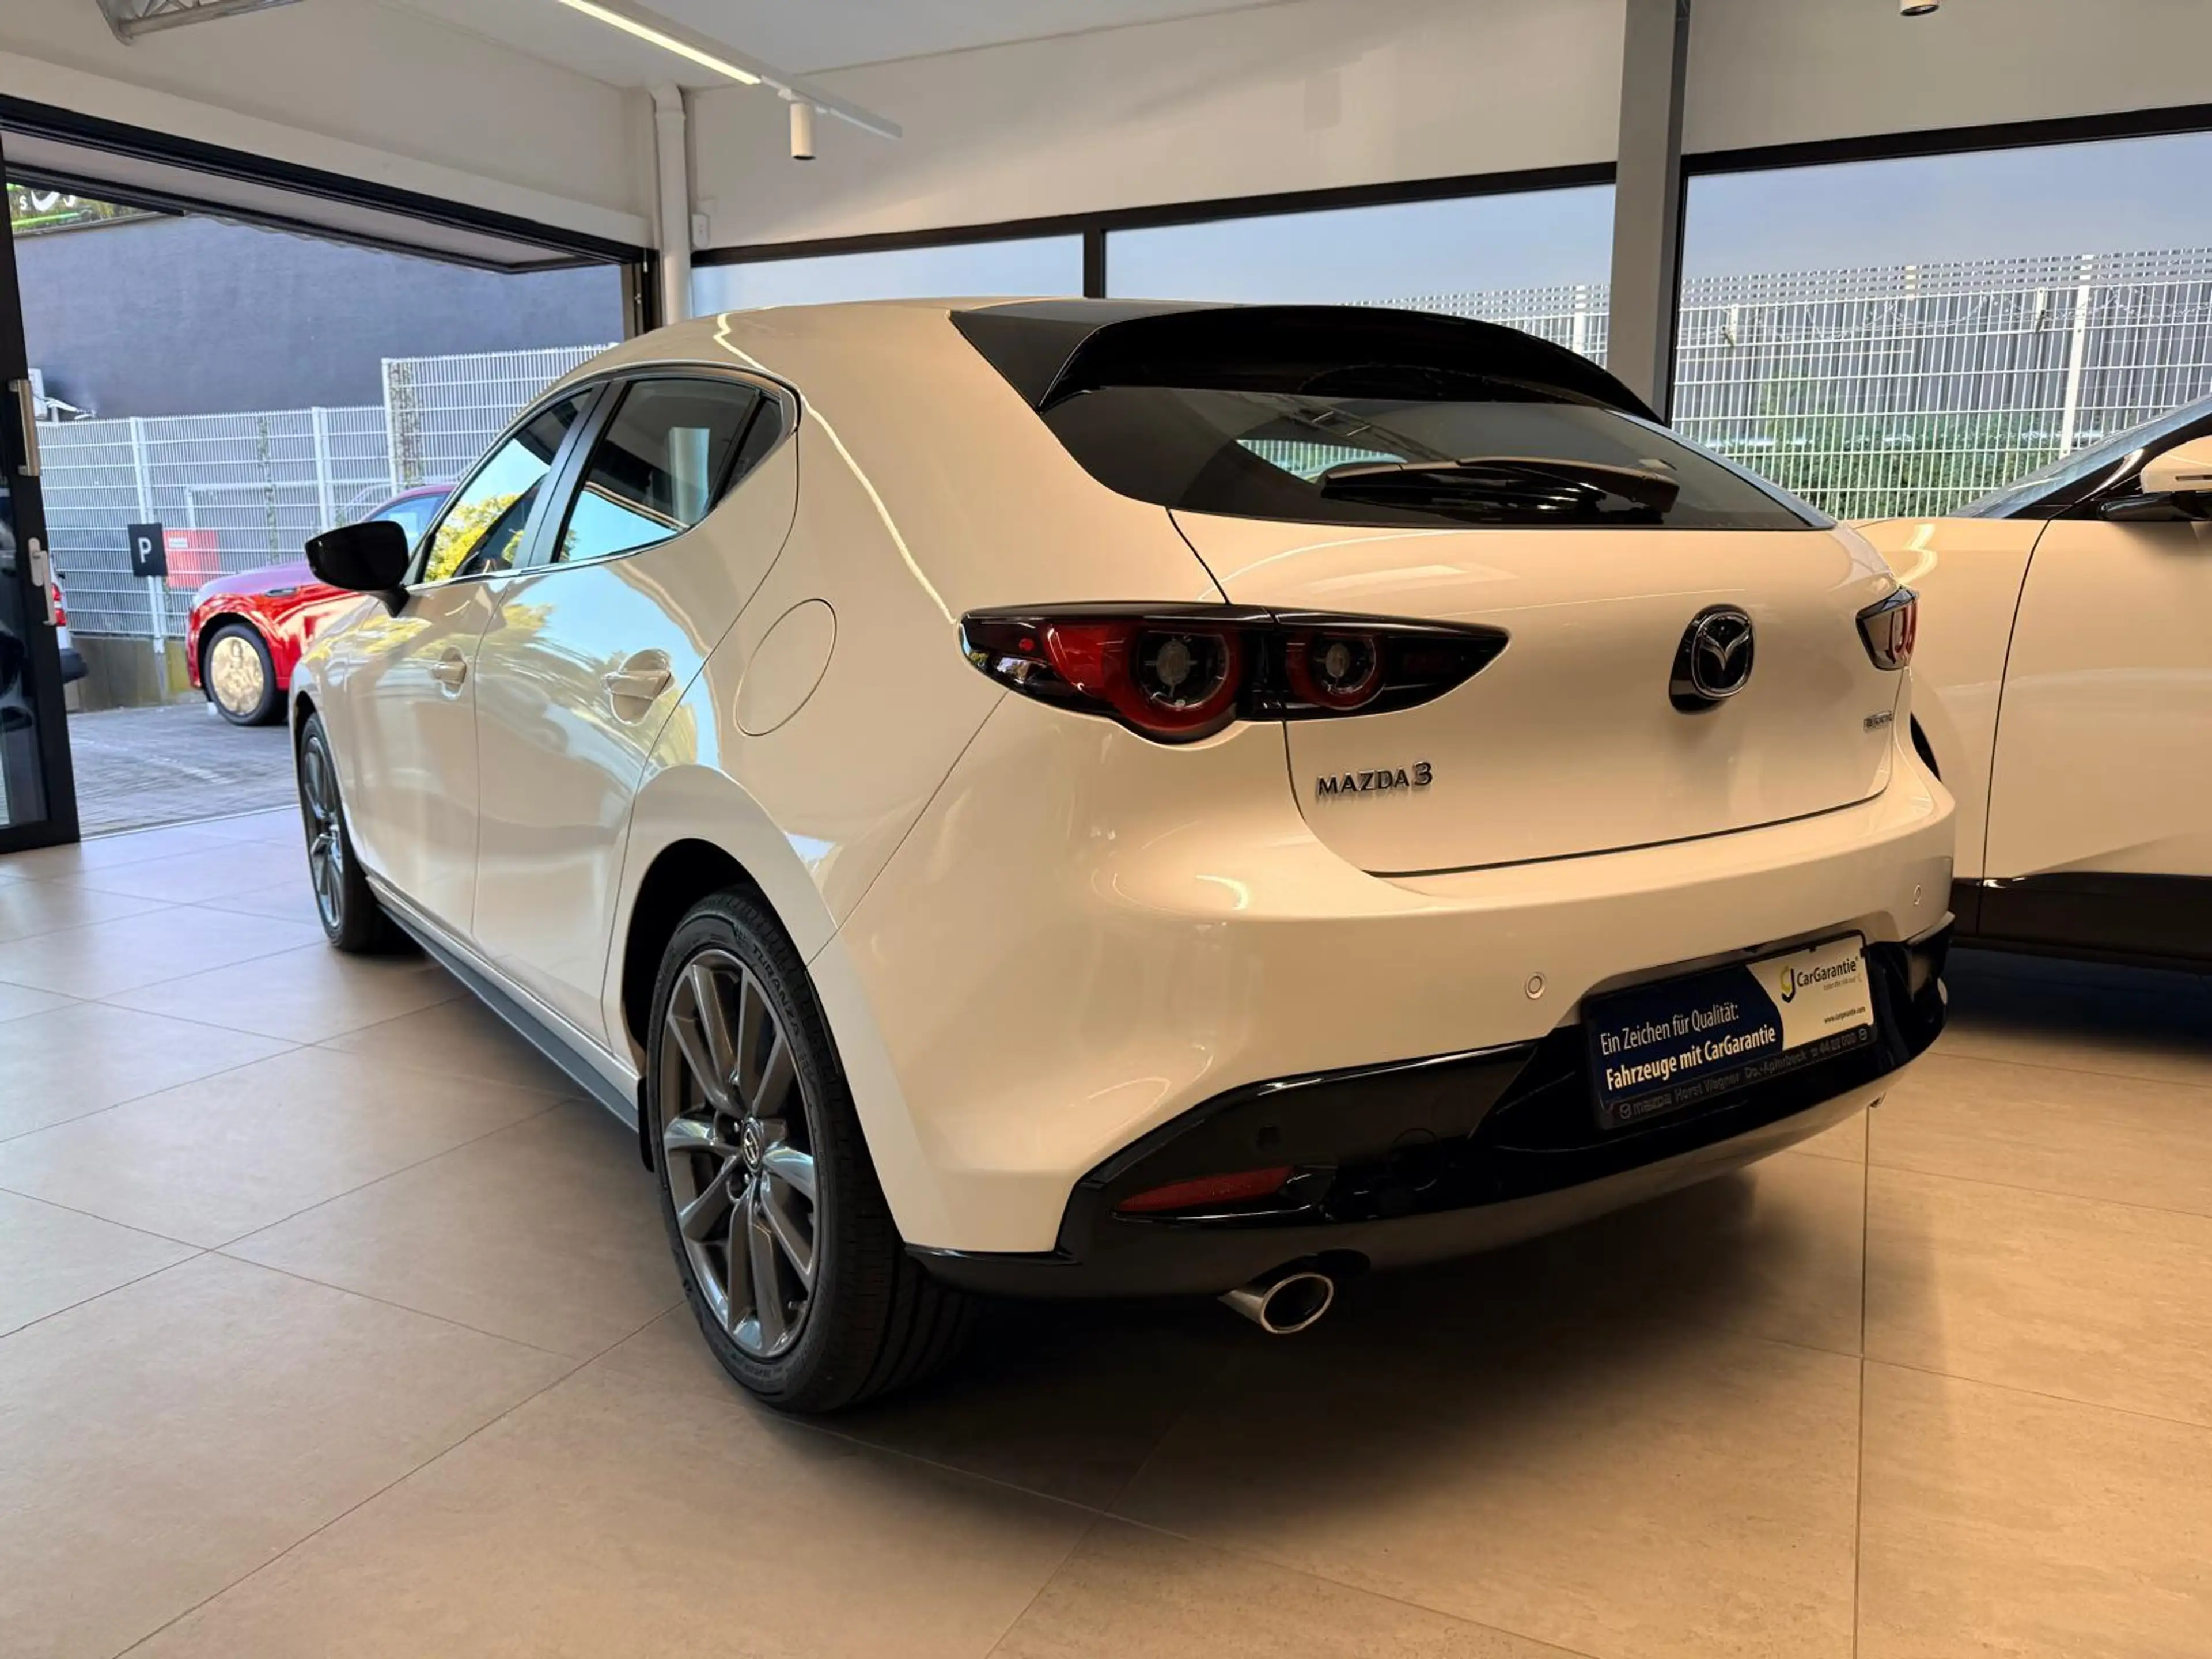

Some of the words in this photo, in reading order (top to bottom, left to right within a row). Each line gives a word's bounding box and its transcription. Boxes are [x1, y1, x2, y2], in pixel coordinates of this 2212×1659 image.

[138, 537, 152, 563] P
[1600, 1031, 1622, 1056] Ein
[1622, 1021, 1671, 1050] Zeichen
[1672, 1014, 1690, 1036] für
[1691, 1002, 1740, 1032] Qualität:
[1605, 1064, 1677, 1092] Fahrzeuge
[1679, 1044, 1703, 1070] mit
[1704, 1024, 1777, 1062] CarGarantie
